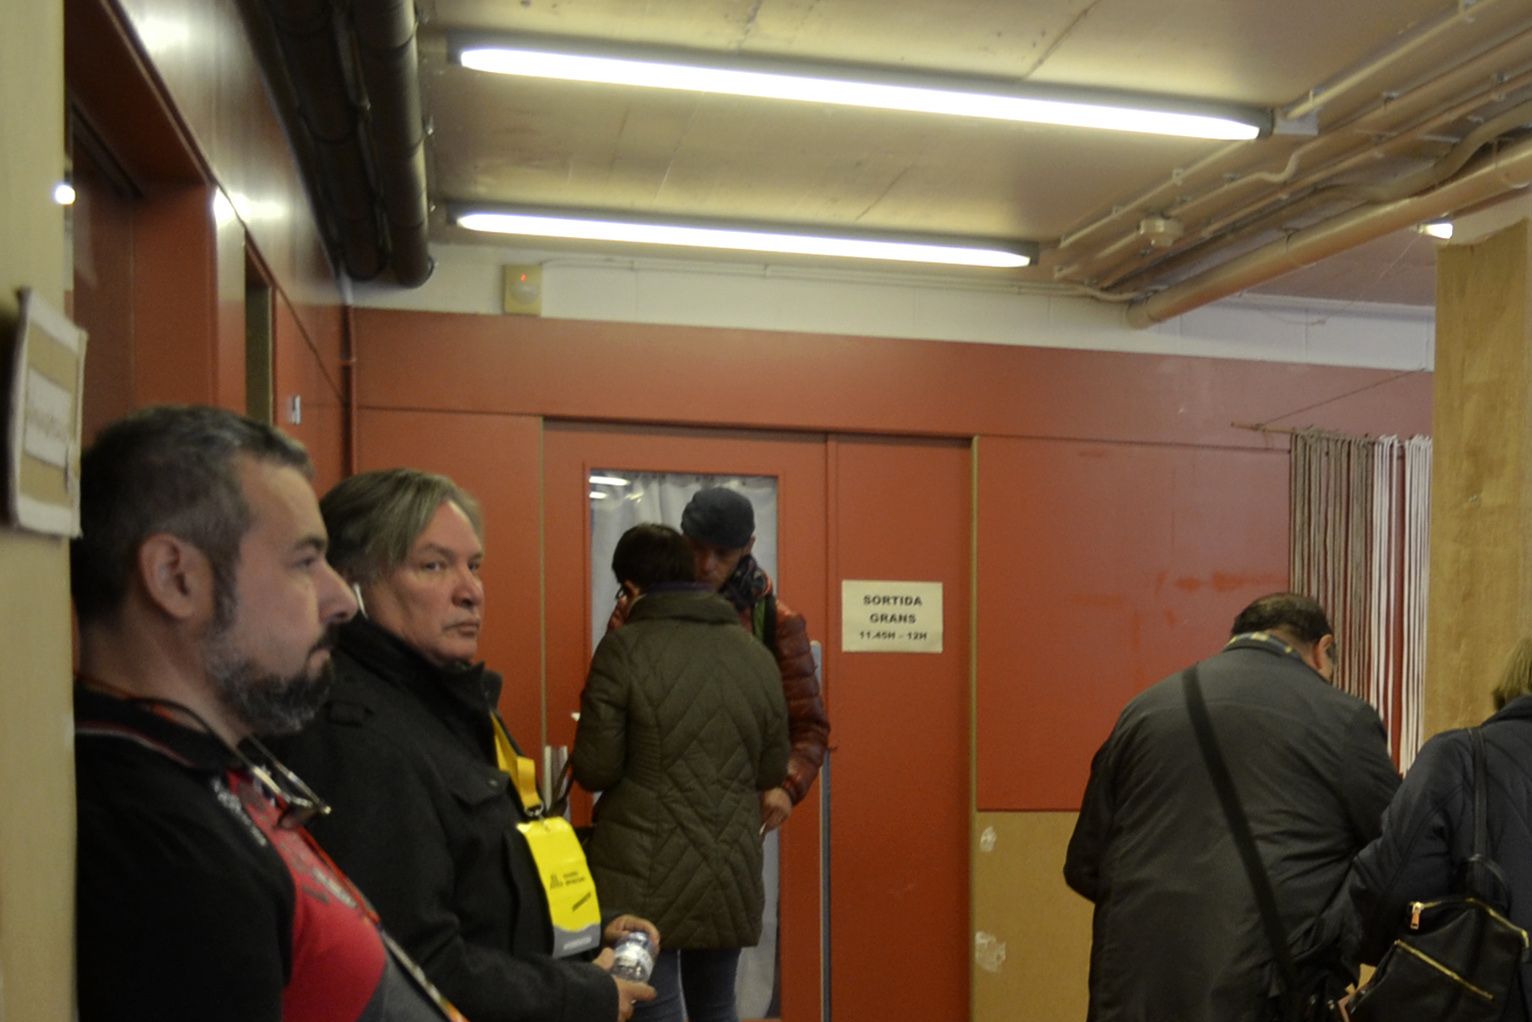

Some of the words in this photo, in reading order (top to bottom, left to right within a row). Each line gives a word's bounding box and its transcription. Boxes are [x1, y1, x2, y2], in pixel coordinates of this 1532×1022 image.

[863, 595, 923, 606] SORTIDA
[869, 613, 917, 624] GRANS
[907, 631, 928, 640] 12H
